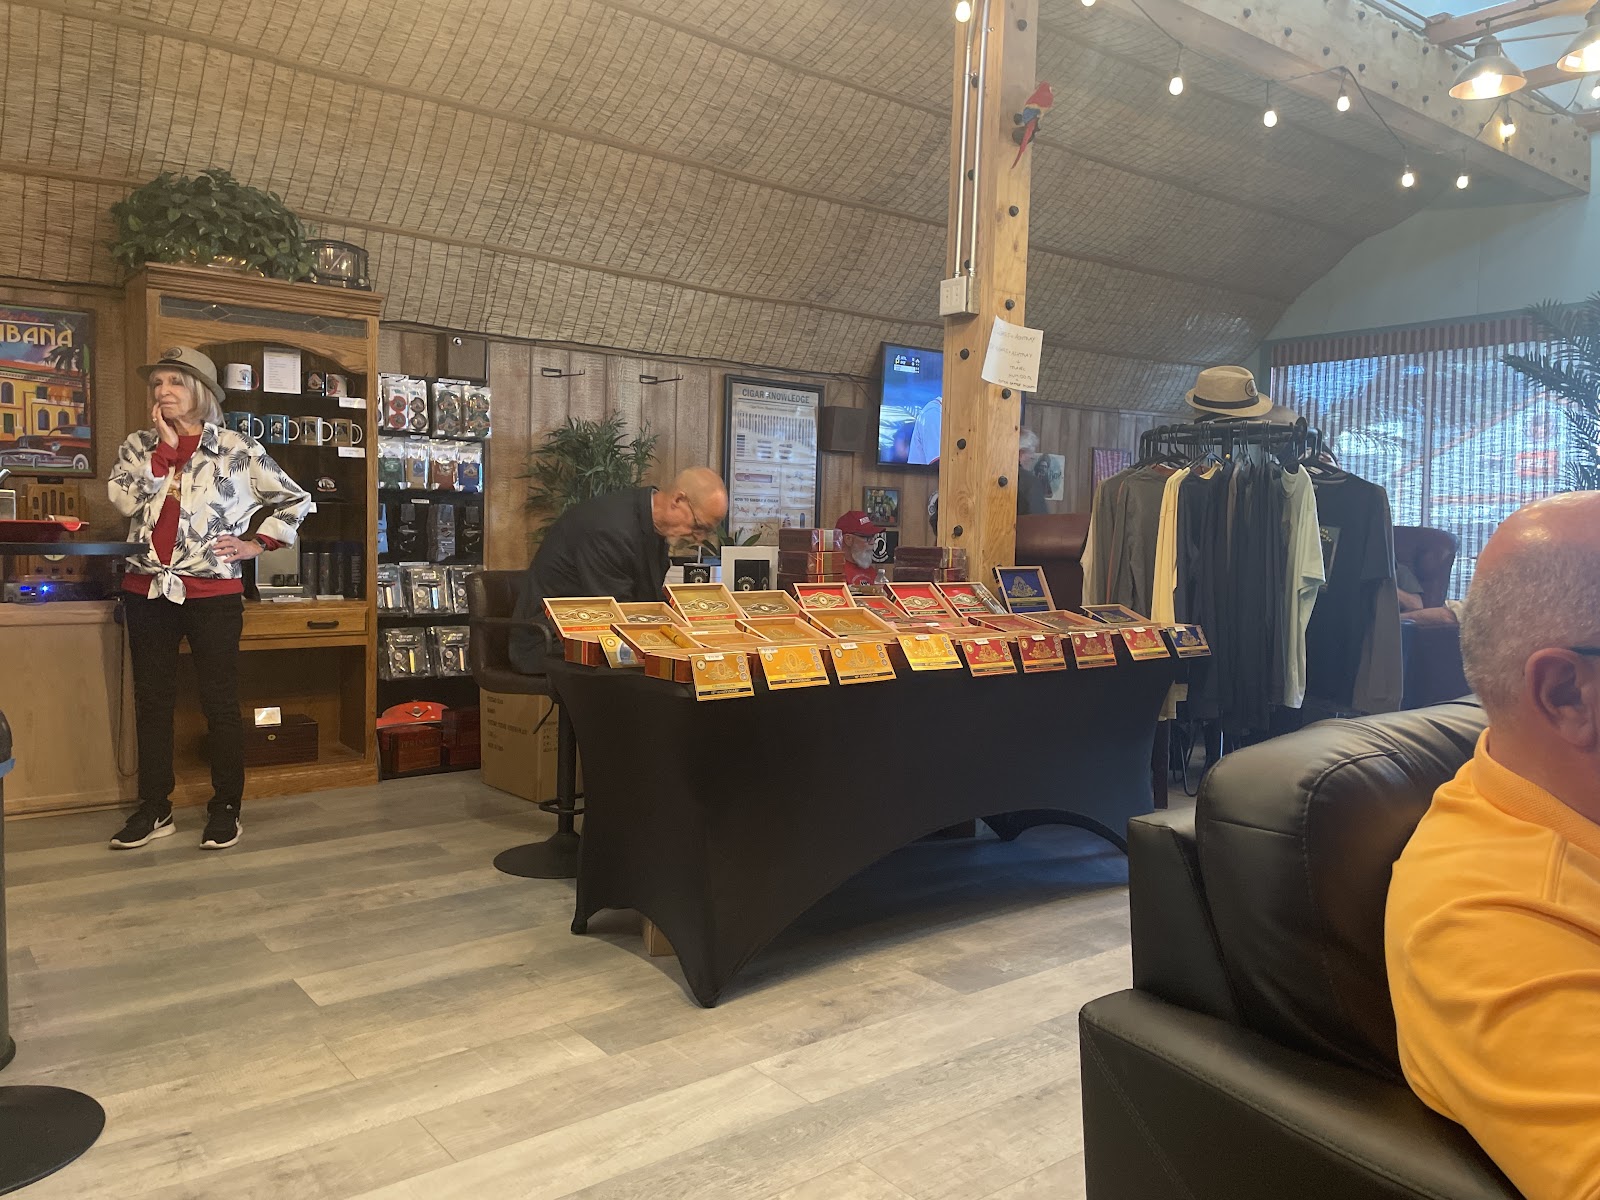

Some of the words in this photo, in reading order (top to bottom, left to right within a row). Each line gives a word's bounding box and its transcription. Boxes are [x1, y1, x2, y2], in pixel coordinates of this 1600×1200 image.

[0, 323, 73, 348] BANA
[742, 388, 764, 399] CIGAR
[766, 392, 809, 404] KNOWLEDGE
